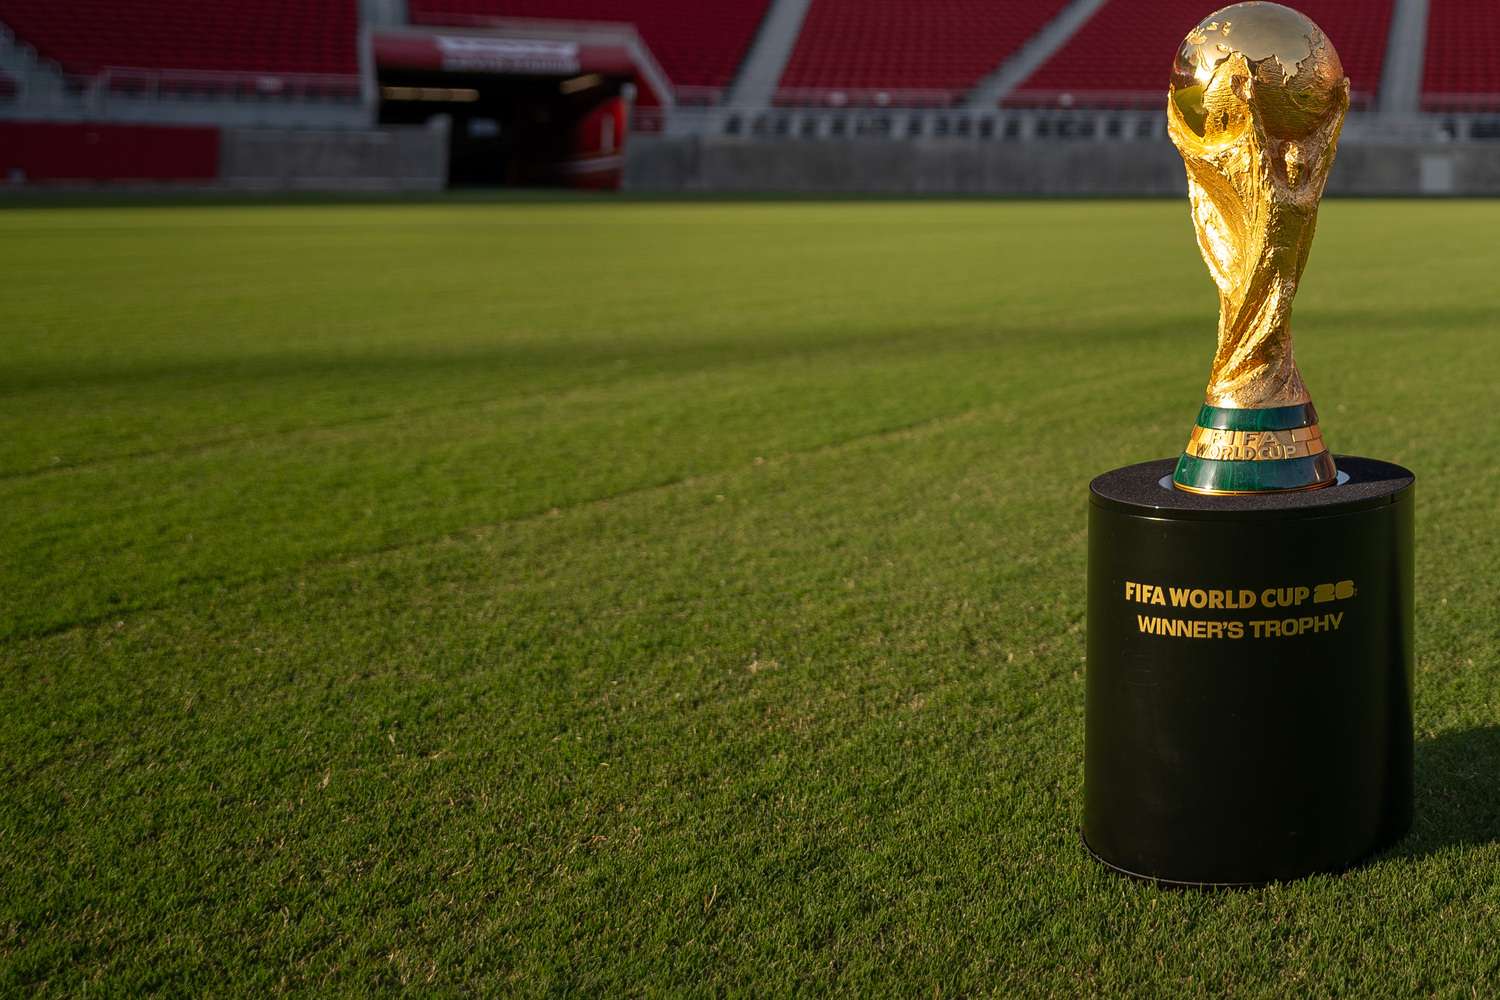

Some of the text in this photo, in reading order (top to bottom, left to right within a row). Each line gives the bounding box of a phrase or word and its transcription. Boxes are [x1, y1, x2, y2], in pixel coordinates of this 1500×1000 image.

[1212, 430, 1279, 446] FIFA
[1197, 443, 1297, 460] WORLD CUP
[1125, 581, 1166, 606] FIFA
[1169, 587, 1257, 609] WORLD
[1261, 586, 1310, 608] CUP
[1137, 612, 1344, 639] WINNER'S TROPHY
